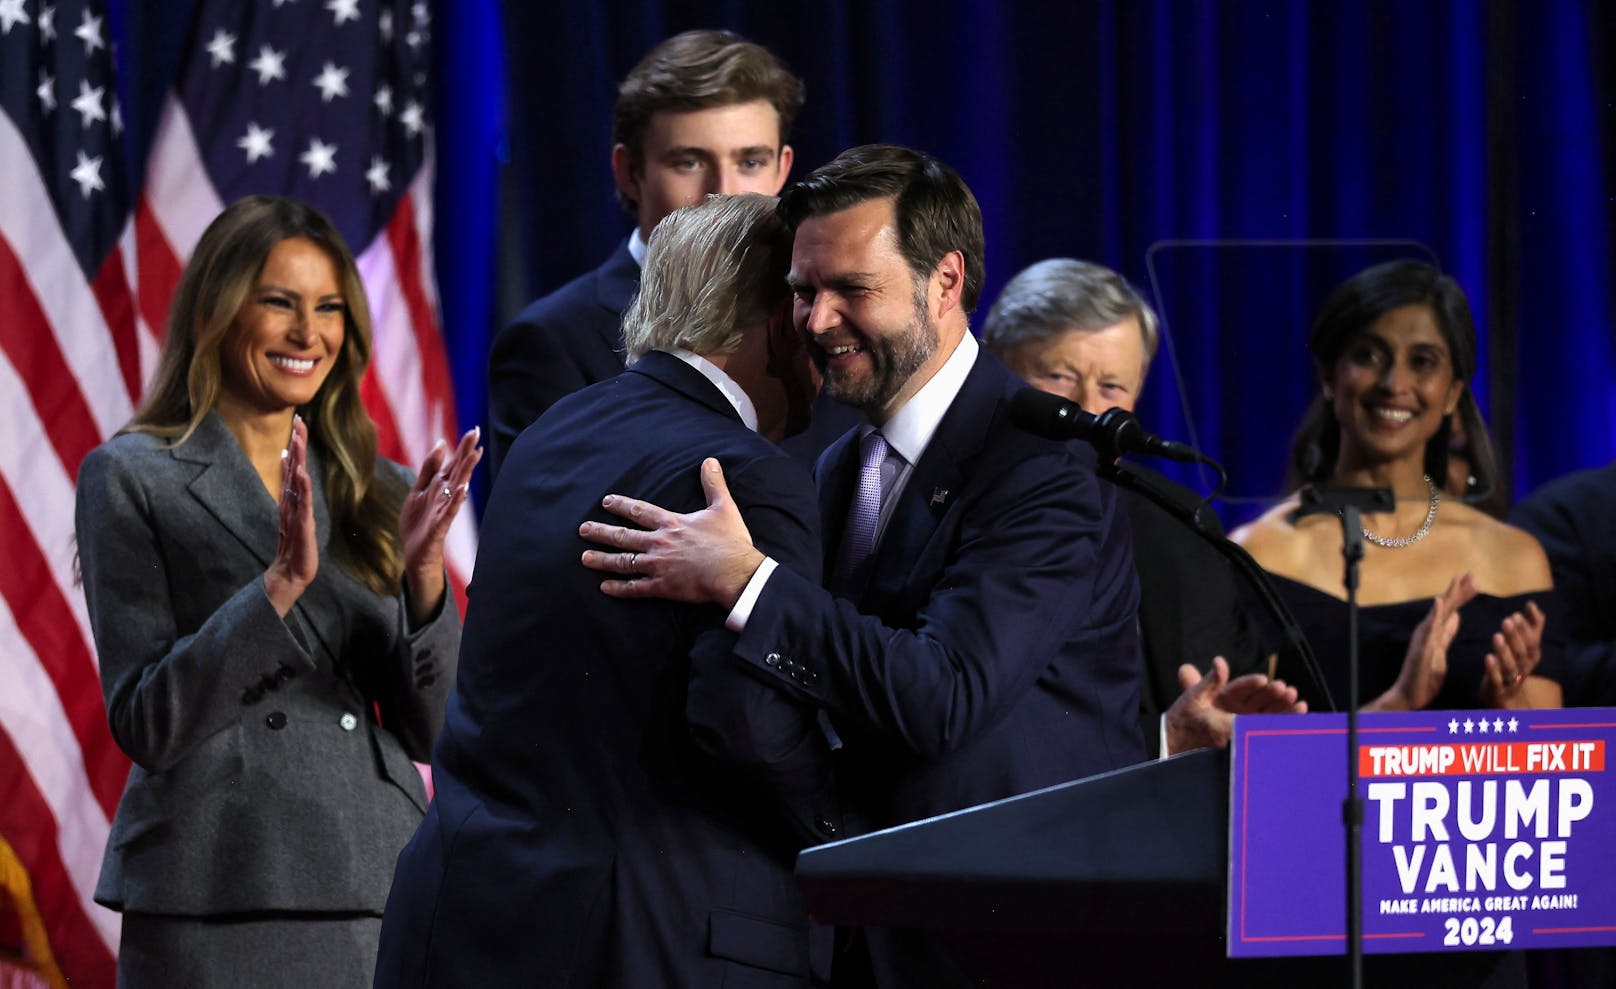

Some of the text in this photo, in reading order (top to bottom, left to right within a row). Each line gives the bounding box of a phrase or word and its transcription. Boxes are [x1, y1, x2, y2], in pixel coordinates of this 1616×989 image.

[1369, 743, 1595, 775] TRUMP WILL FIX IT
[1368, 779, 1593, 842] TRUMP
[1393, 841, 1566, 893] VANCE
[1380, 895, 1577, 914] MAKE AMERICA GREAT AGAIN!
[1444, 916, 1513, 945] 2024
